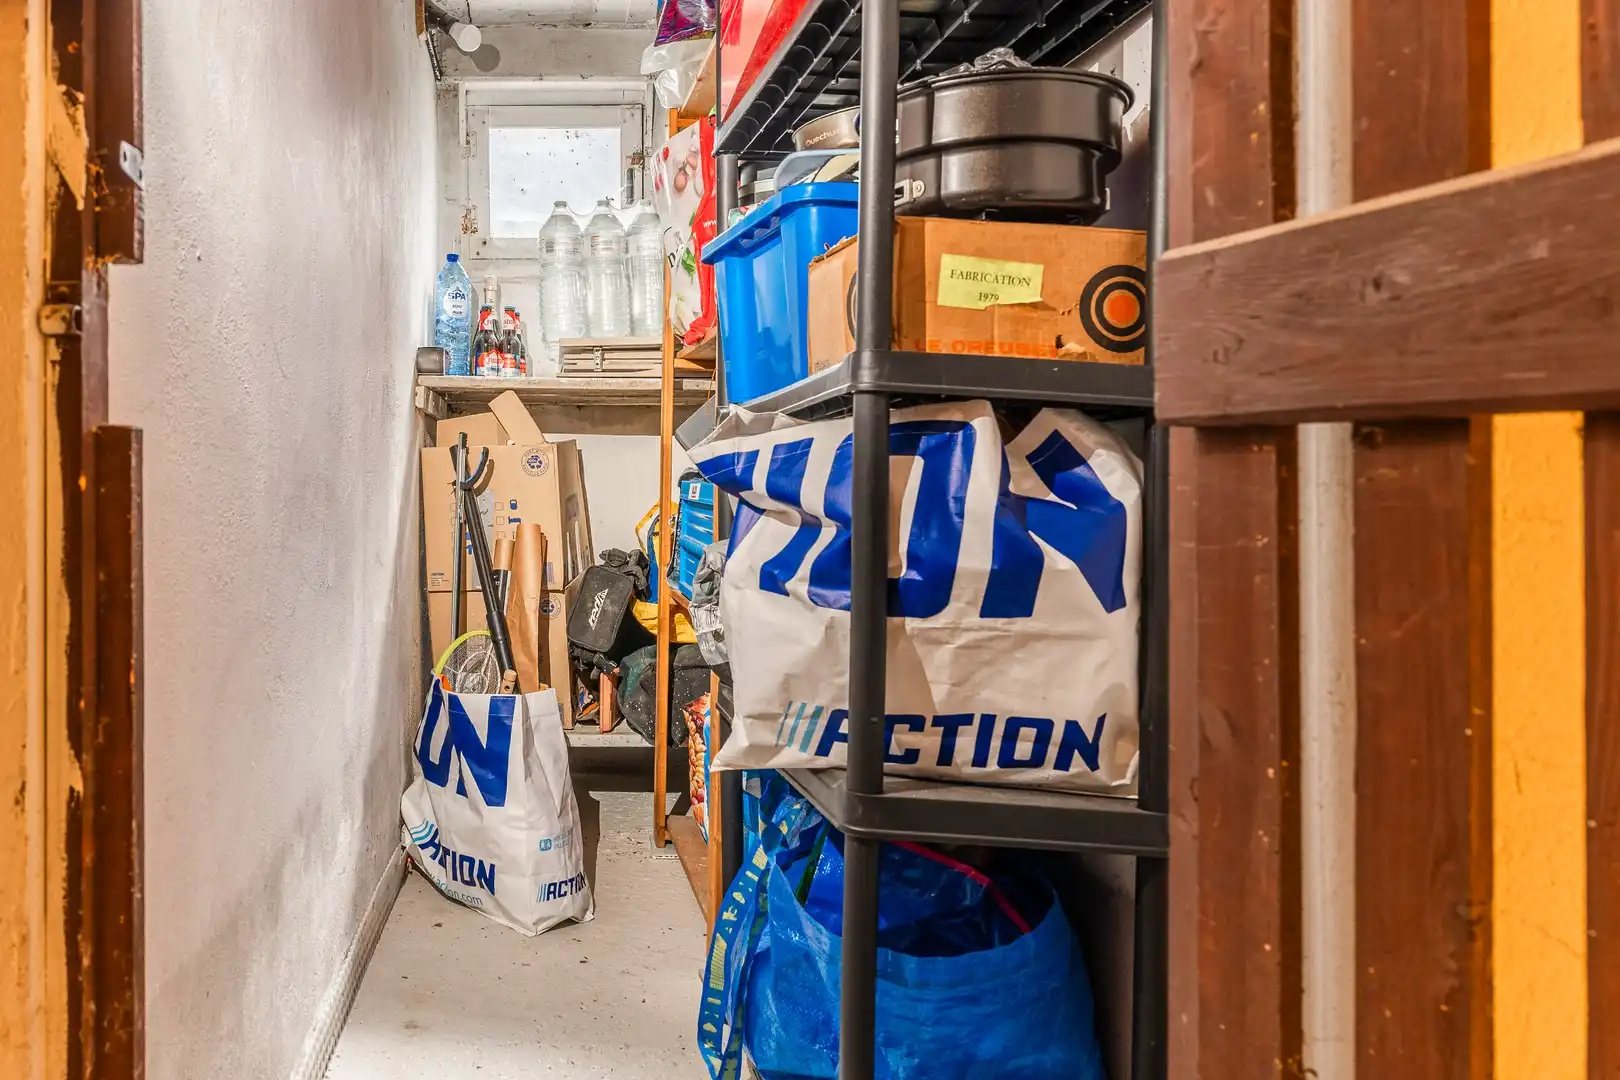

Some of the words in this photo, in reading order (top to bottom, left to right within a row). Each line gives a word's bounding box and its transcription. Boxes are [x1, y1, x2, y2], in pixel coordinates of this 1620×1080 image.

[949, 269, 1032, 287] FABRICATION
[447, 292, 466, 301] SPA
[977, 292, 1000, 303] 1979
